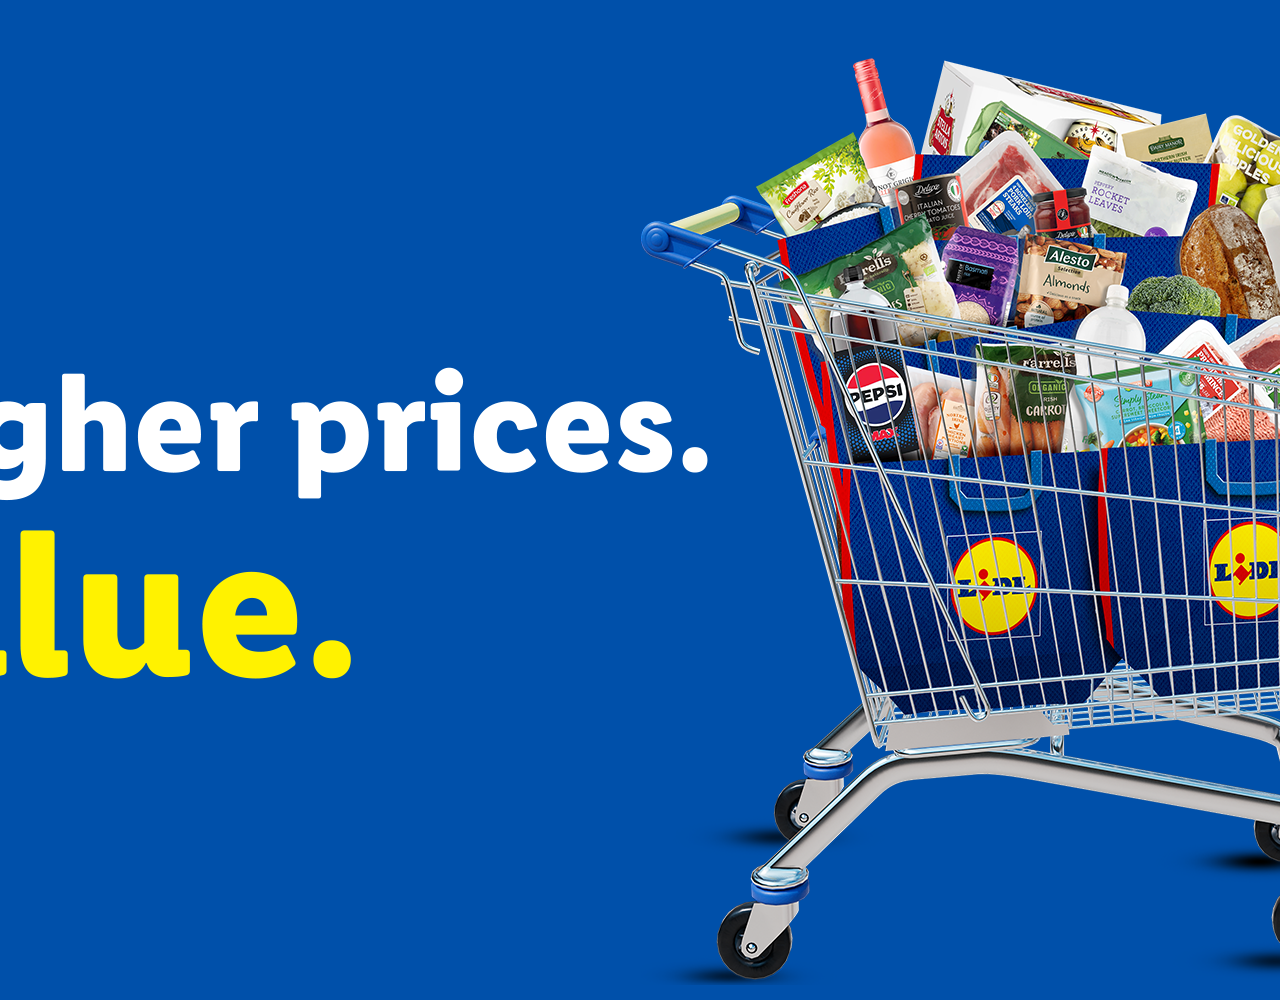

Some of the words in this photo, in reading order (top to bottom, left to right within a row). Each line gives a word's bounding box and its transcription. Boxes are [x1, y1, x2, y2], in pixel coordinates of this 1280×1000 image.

[1223, 154, 1270, 185] APPLES
[914, 183, 942, 197] Deluxe
[1091, 186, 1130, 205] ROCKET
[917, 199, 944, 210] ITALIAN
[927, 203, 961, 216] TOMATOES
[1003, 192, 1022, 215] STEAKS
[1008, 188, 1021, 205] PORK
[1020, 203, 1034, 219] LOIN
[1088, 195, 1123, 213] LEAVES
[1049, 250, 1090, 267] Alesto
[964, 264, 989, 275] Basmati
[1043, 274, 1091, 293] Almonds
[850, 383, 903, 404] PEPSI
